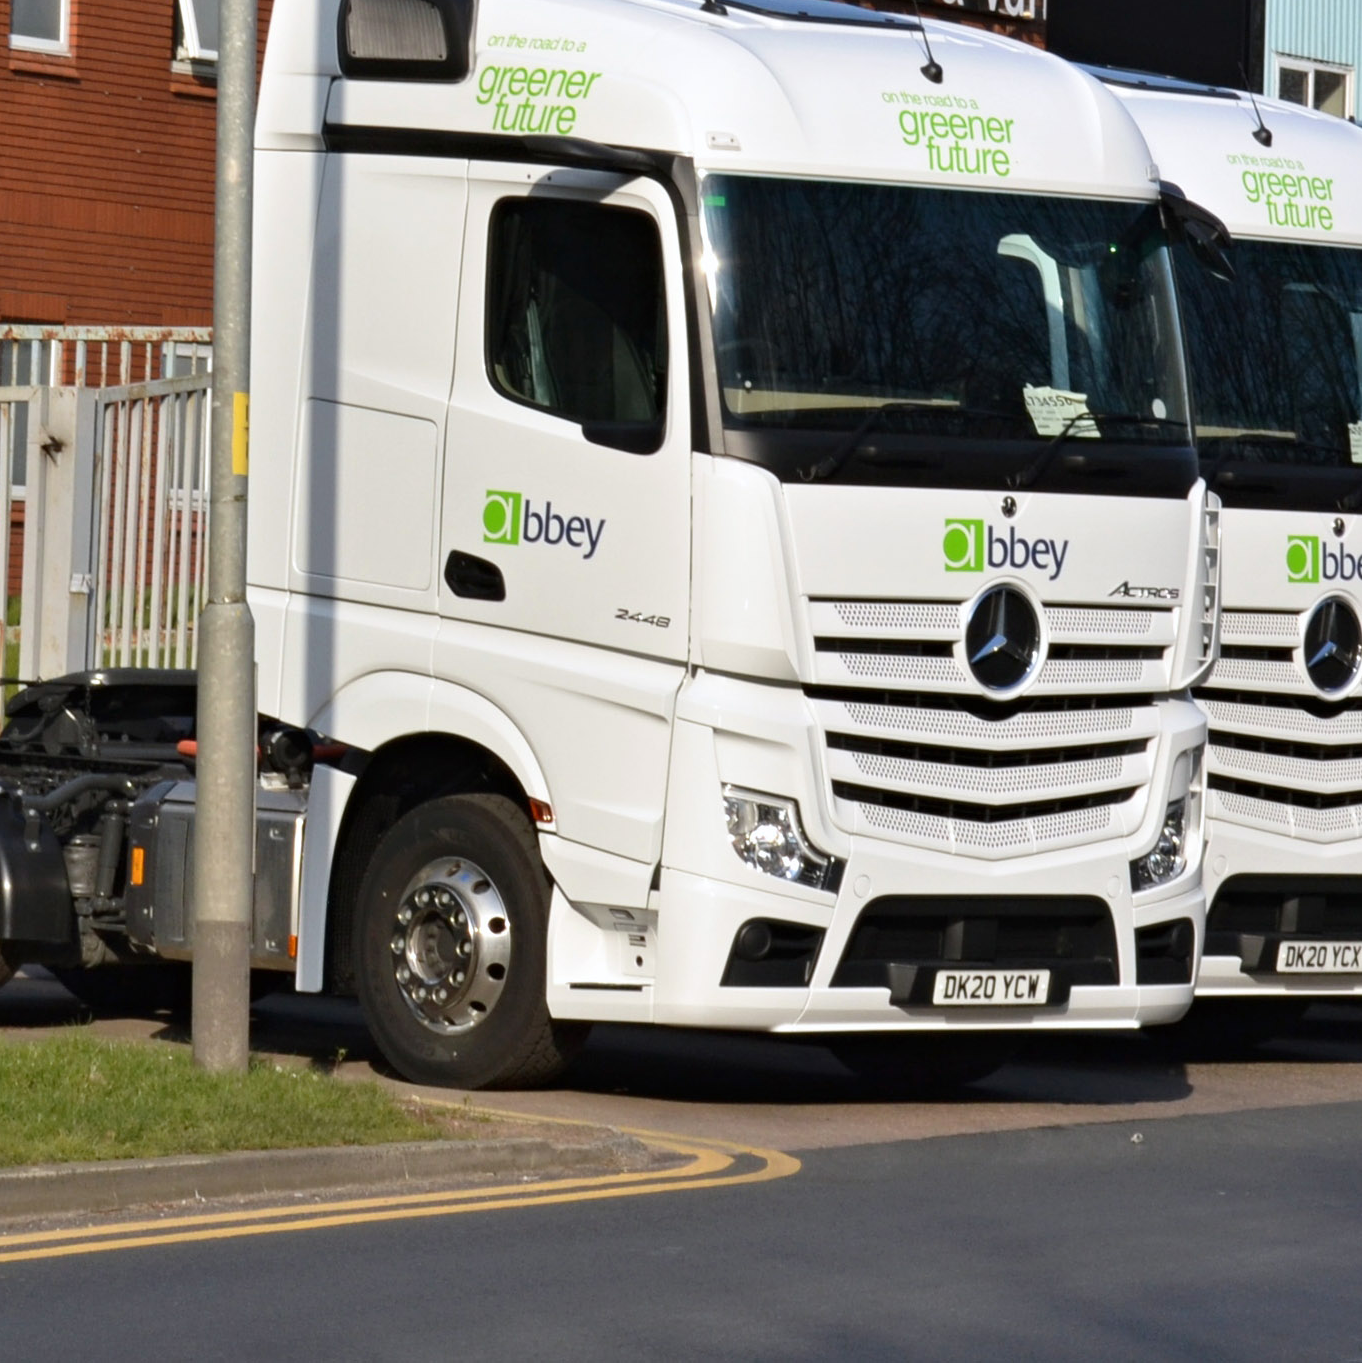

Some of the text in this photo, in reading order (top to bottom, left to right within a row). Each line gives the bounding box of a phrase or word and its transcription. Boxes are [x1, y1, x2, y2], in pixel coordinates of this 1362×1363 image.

[487, 34, 587, 53] on the road to a
[476, 65, 603, 105] greener
[881, 91, 979, 110] on the road to a
[492, 93, 577, 135] future
[899, 110, 1014, 146] greener
[926, 136, 1010, 177] future
[1242, 170, 1333, 203] greener
[1265, 194, 1333, 231] future
[482, 490, 606, 559] abbey
[943, 519, 1069, 581] abbey
[1108, 581, 1179, 599] ACTROS
[615, 607, 672, 629] 2448
[1285, 946, 1362, 969] DK20 YCX
[943, 975, 1039, 999] DK20 YCW
